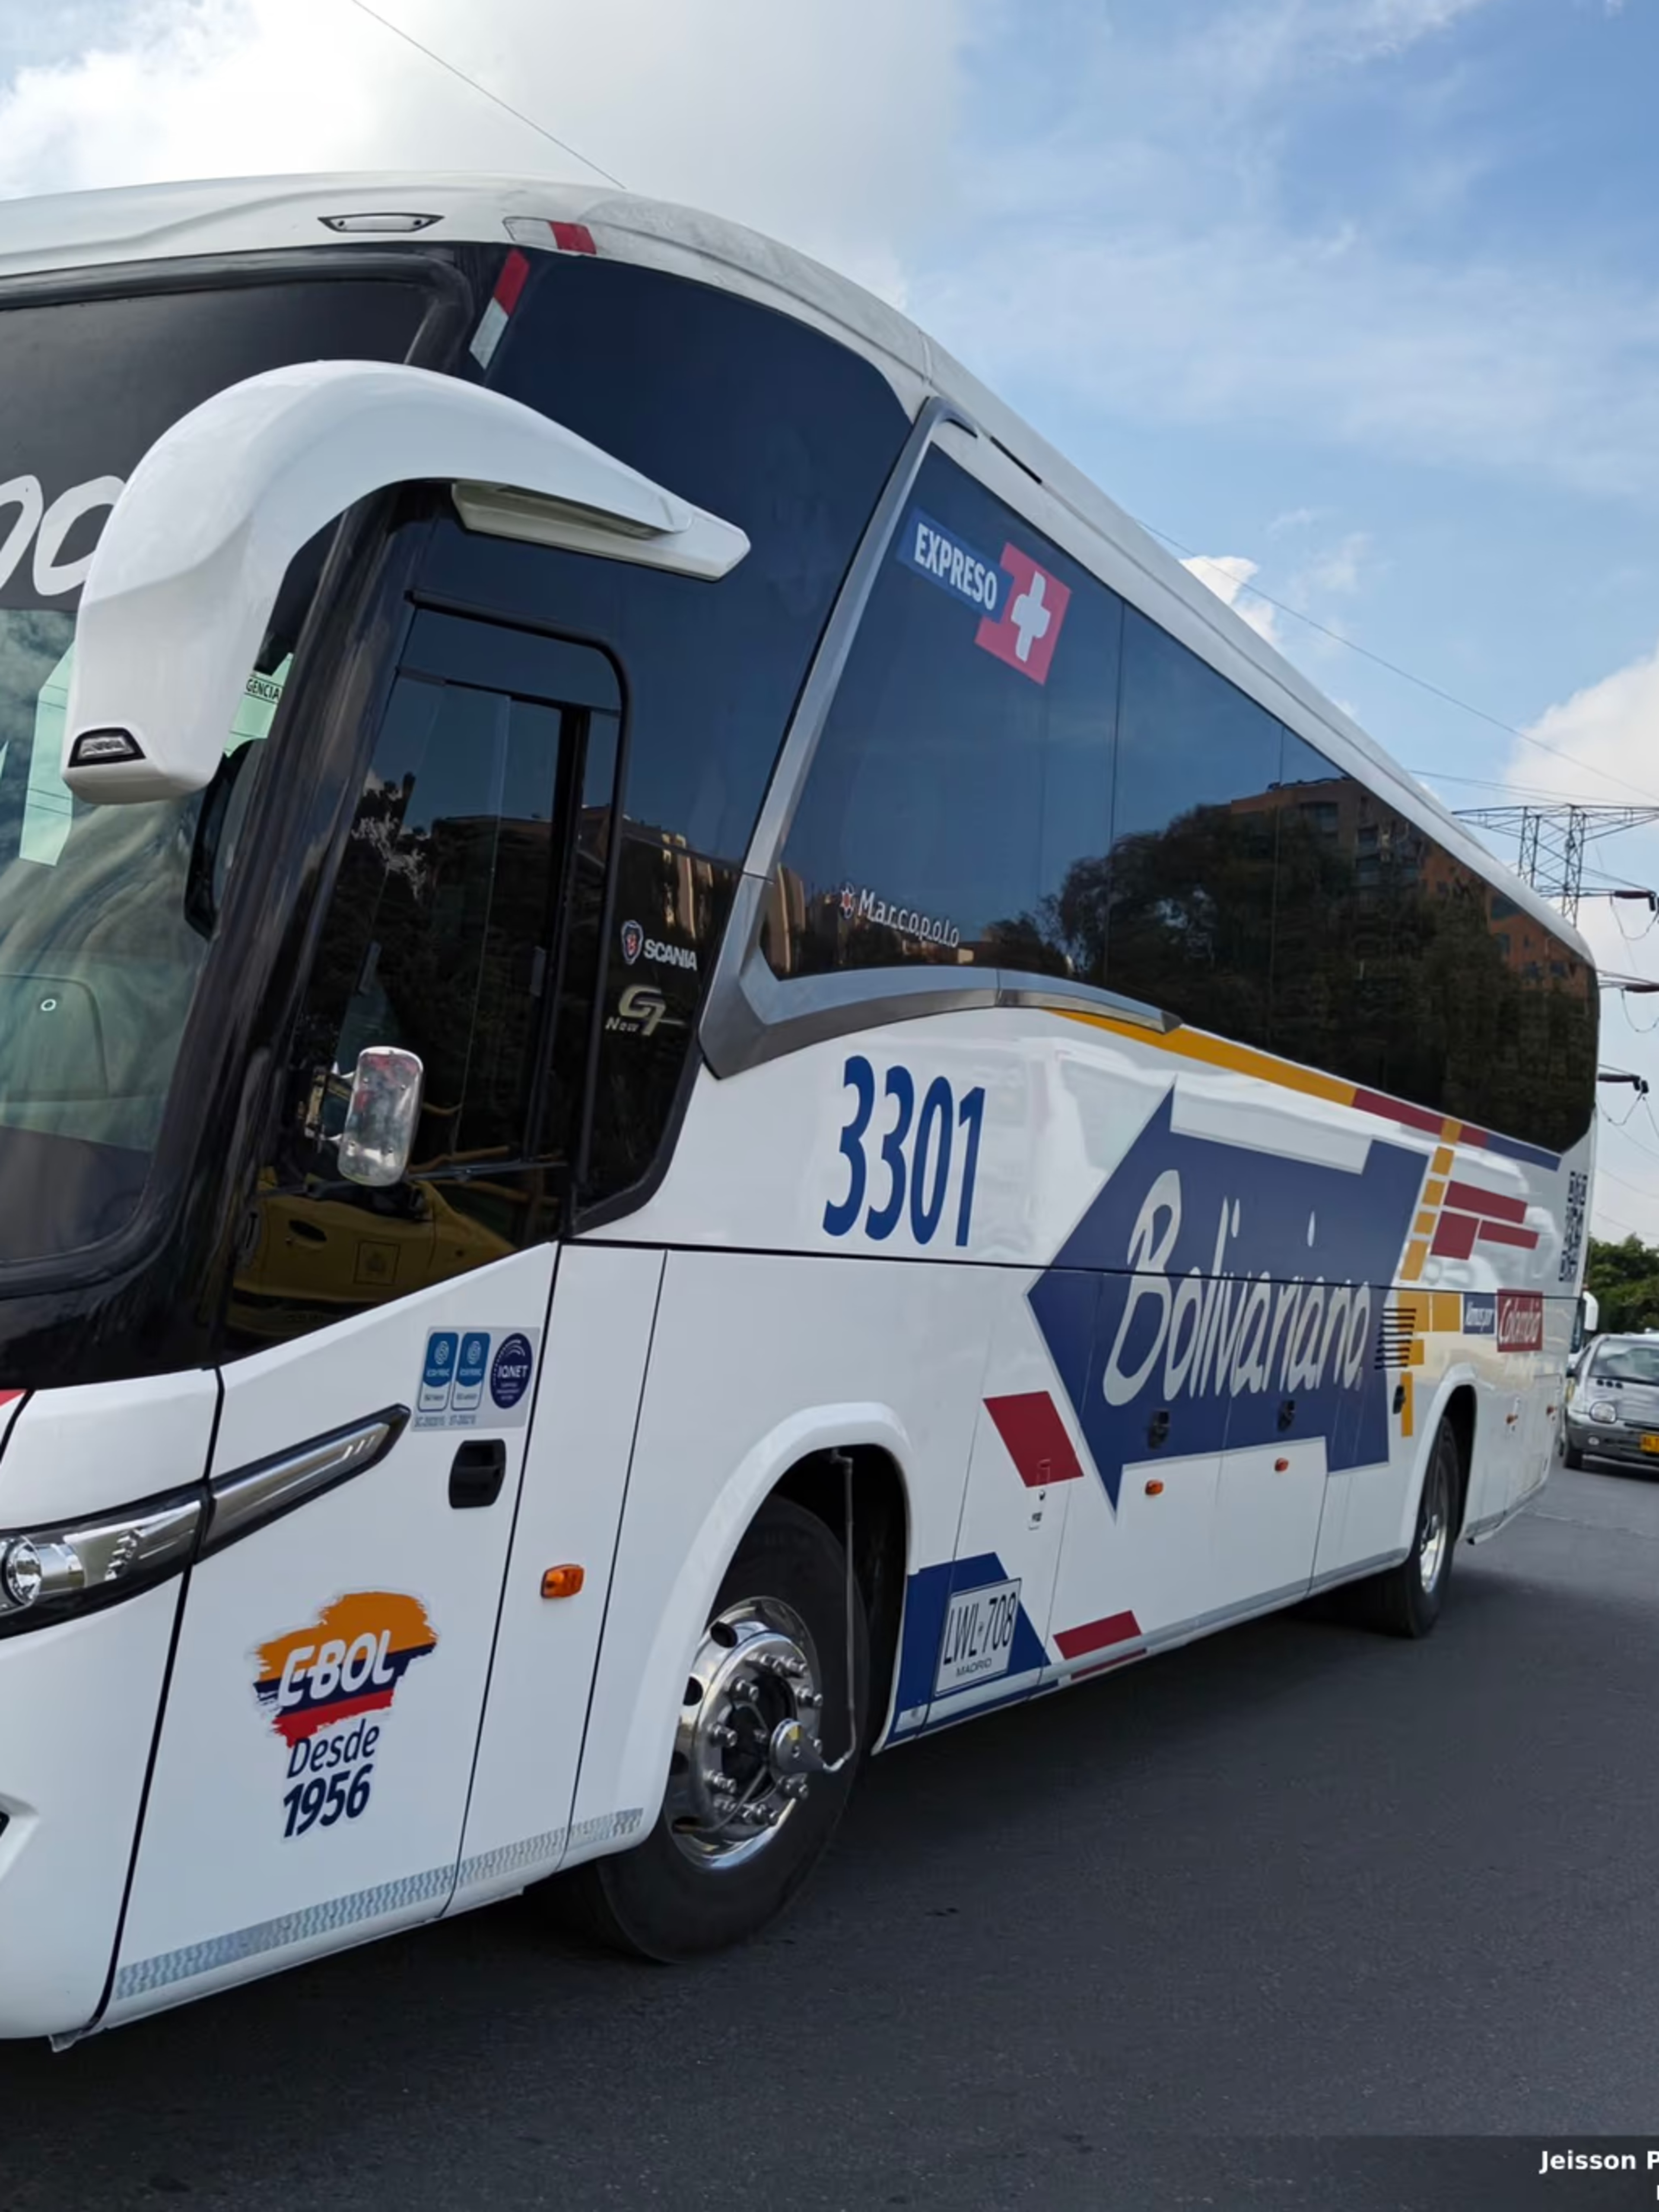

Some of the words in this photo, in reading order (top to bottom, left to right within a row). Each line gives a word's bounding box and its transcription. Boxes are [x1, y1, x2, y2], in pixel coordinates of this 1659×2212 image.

[914, 522, 998, 611] EXPRESO
[644, 938, 697, 971] SCANIA
[858, 888, 959, 948] Marcopolo
[822, 1055, 985, 1247] 3301
[1103, 1169, 1370, 1406] Bolivariano
[287, 1718, 380, 1779] Desde
[283, 1763, 373, 1837] 1956
